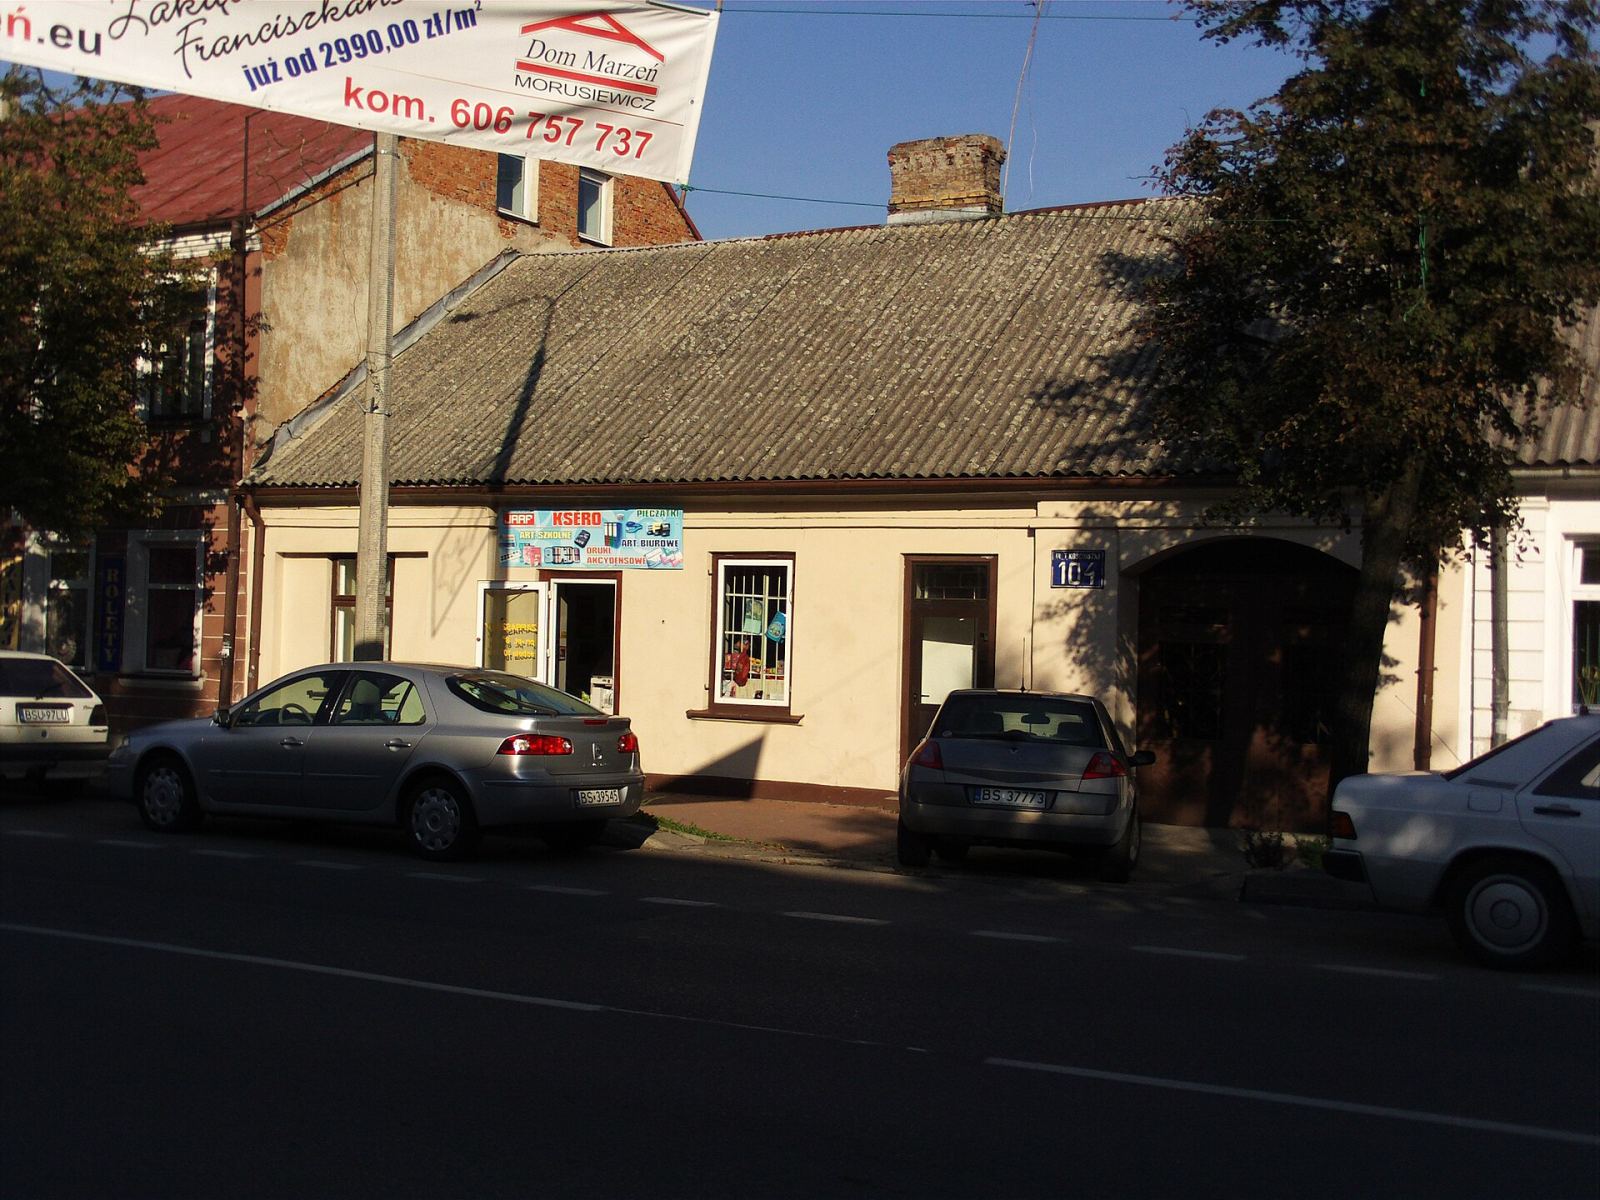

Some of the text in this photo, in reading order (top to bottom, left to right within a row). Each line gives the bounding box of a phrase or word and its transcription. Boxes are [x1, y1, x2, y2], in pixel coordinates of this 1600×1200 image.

[0, 6, 102, 56] ń.eu
[241, 57, 283, 92] już
[284, 47, 317, 78] od
[319, 19, 420, 68] 2990,00
[525, 38, 658, 82] Dom Marzeń
[514, 74, 656, 112] MORUSIEWICZ
[344, 76, 653, 159] kom. 606 757 737
[552, 511, 601, 526] KSERO
[586, 546, 611, 554] DRUKI
[640, 539, 679, 548] BIUROWE
[104, 568, 120, 663] ROLETY
